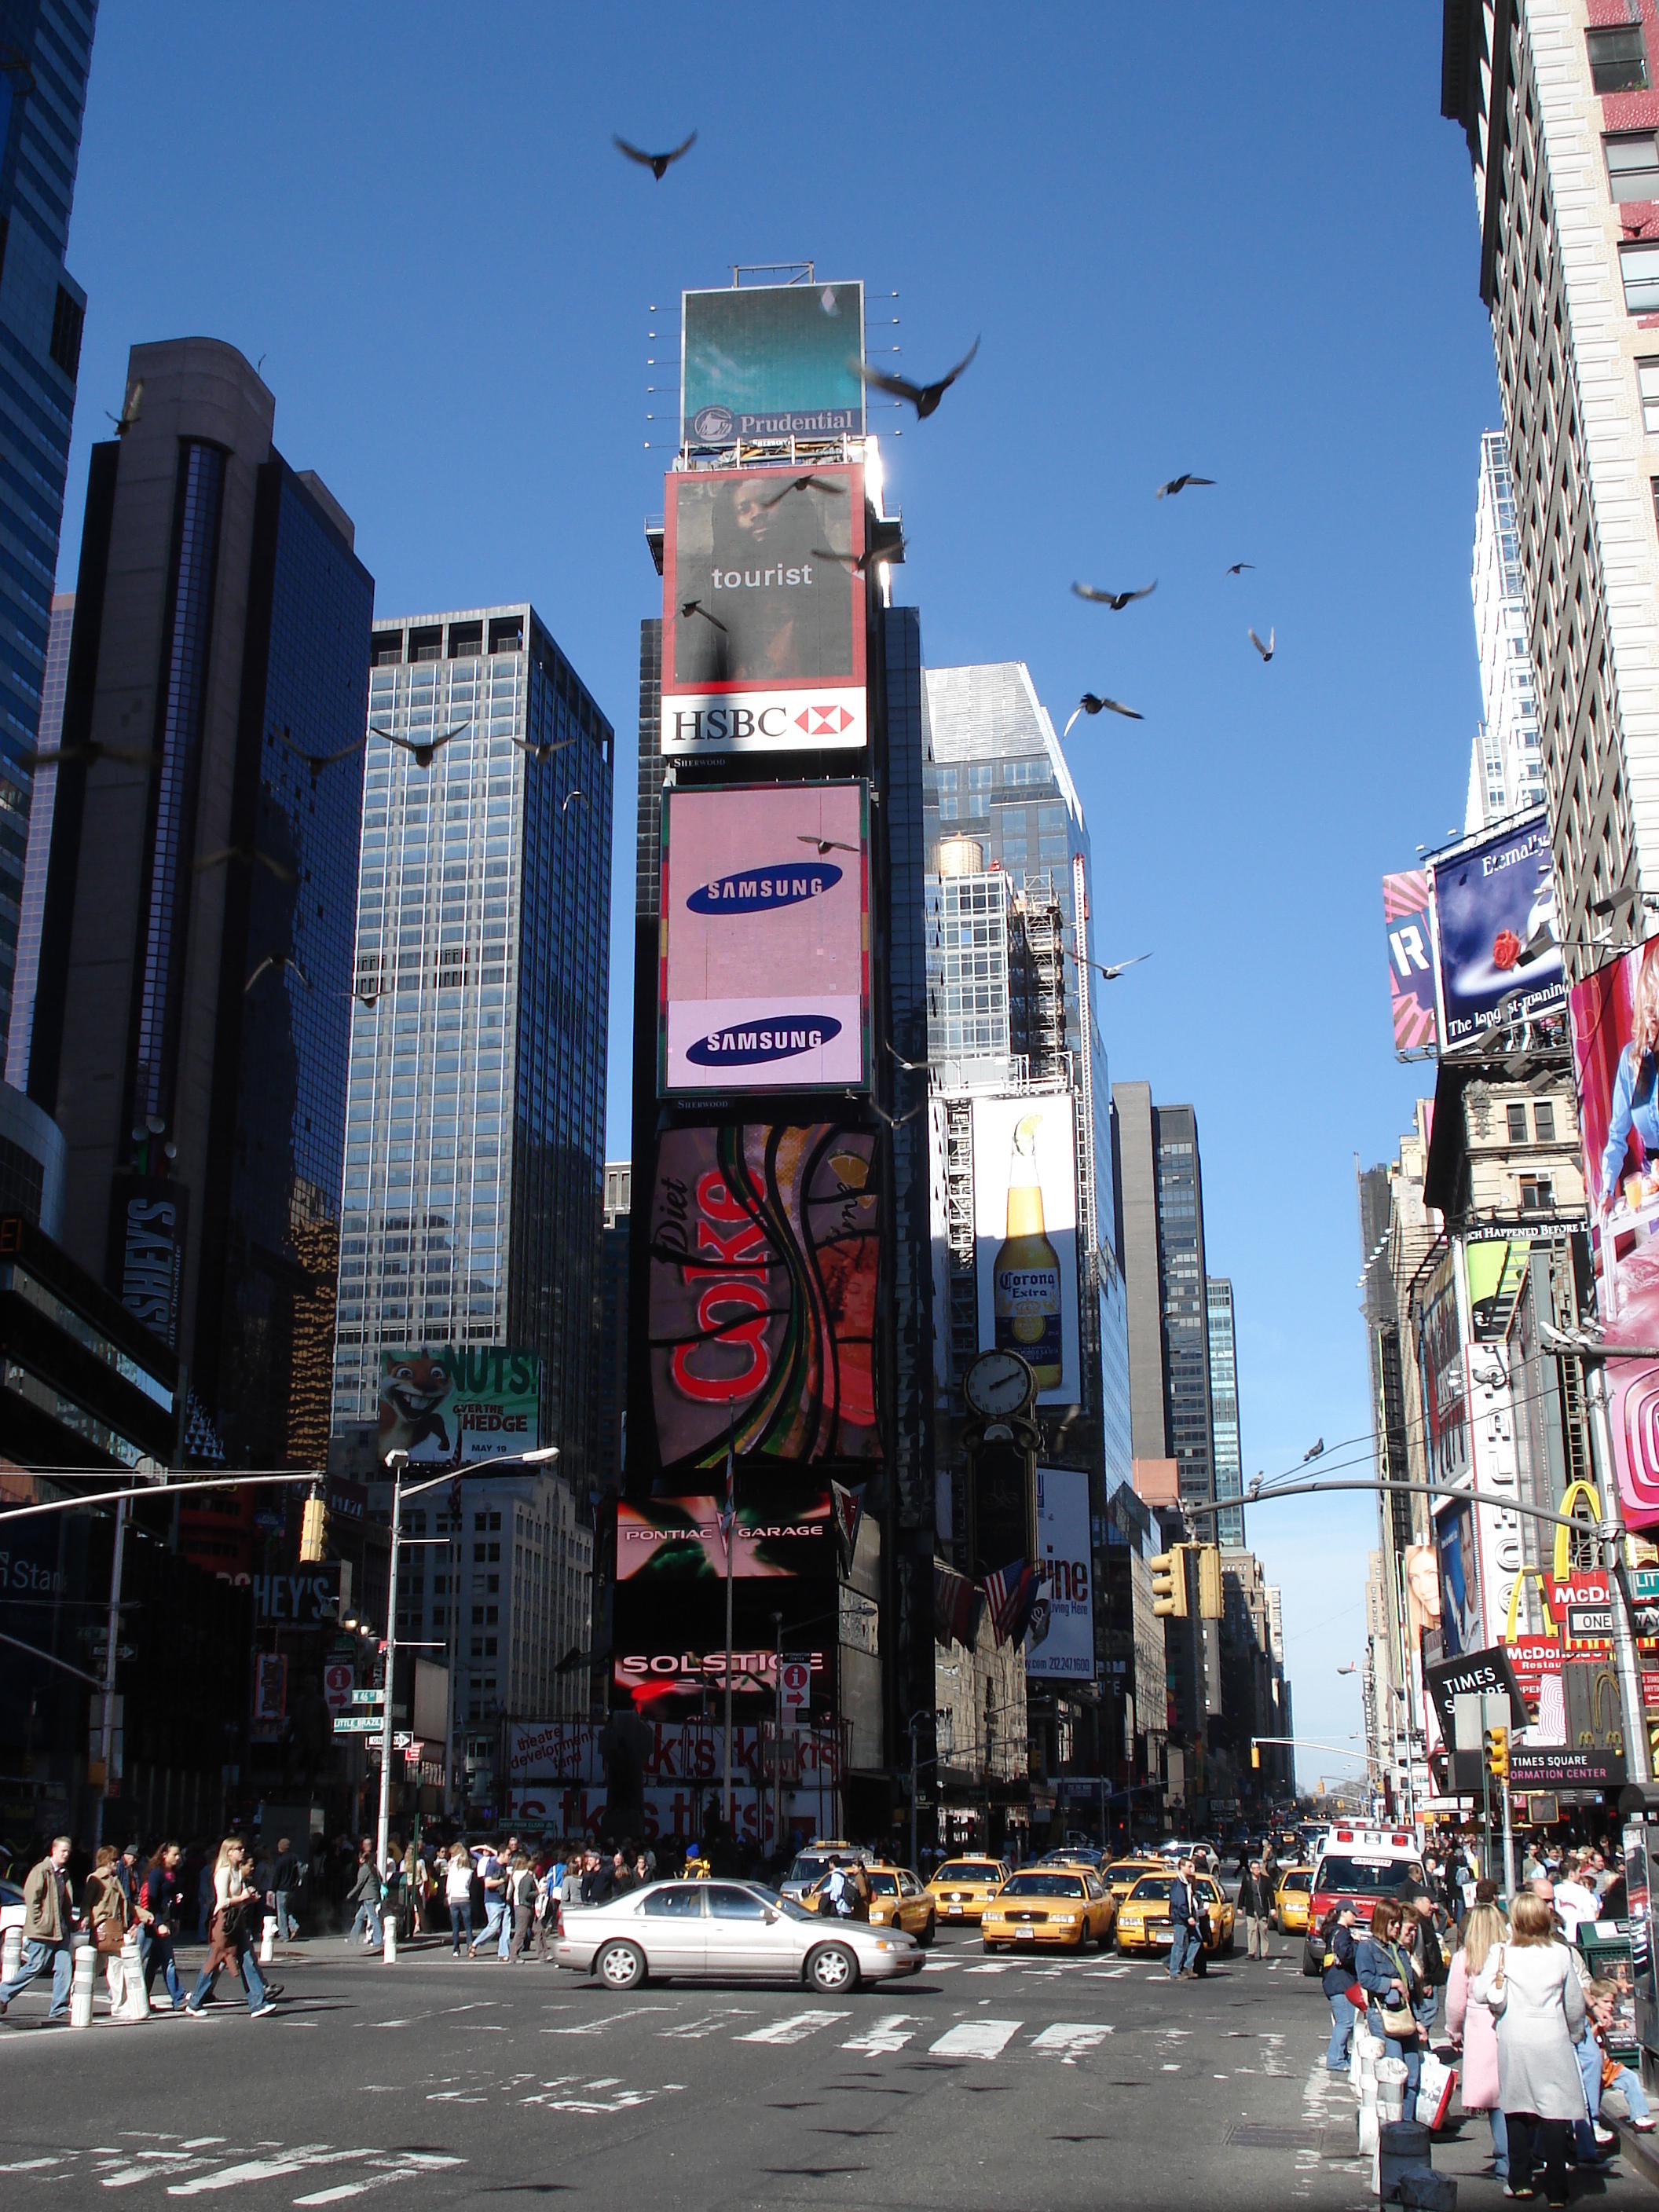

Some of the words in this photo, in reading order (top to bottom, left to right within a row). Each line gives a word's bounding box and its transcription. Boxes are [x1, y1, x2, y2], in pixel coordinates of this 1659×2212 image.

[740, 410, 852, 434] Prudential
[712, 563, 813, 589] tourist
[672, 707, 787, 741] HSBC
[707, 877, 823, 899] SAMSUNG
[1448, 1016, 1472, 1037] The
[706, 1030, 822, 1051] SAMSUNG
[654, 1177, 689, 1254] Diet
[669, 1166, 772, 1404] Coke
[999, 1271, 1055, 1291] Corona
[1013, 1288, 1048, 1298] Extra
[444, 1344, 540, 1395] NUTS!
[483, 1404, 504, 1415] THE
[462, 1415, 528, 1433] HEDGE
[471, 1444, 493, 1452] MAY
[496, 1445, 507, 1453] 19
[625, 1528, 713, 1540] PONTIAC
[738, 1525, 824, 1537] GARAGE
[1583, 1615, 1612, 1628] ONE
[1442, 1667, 1496, 1694] TIMES
[359, 1692, 368, 1701] 46
[1363, 1675, 1373, 1738] WELLINGTON
[334, 1719, 356, 1727] LITTLE
[357, 1718, 380, 1727] BRAZIL
[517, 1726, 562, 1751] theatre
[1512, 1756, 1545, 1767] TIMES
[1547, 1755, 1588, 1766] SQUARE
[1566, 1768, 1606, 1778] CENTER
